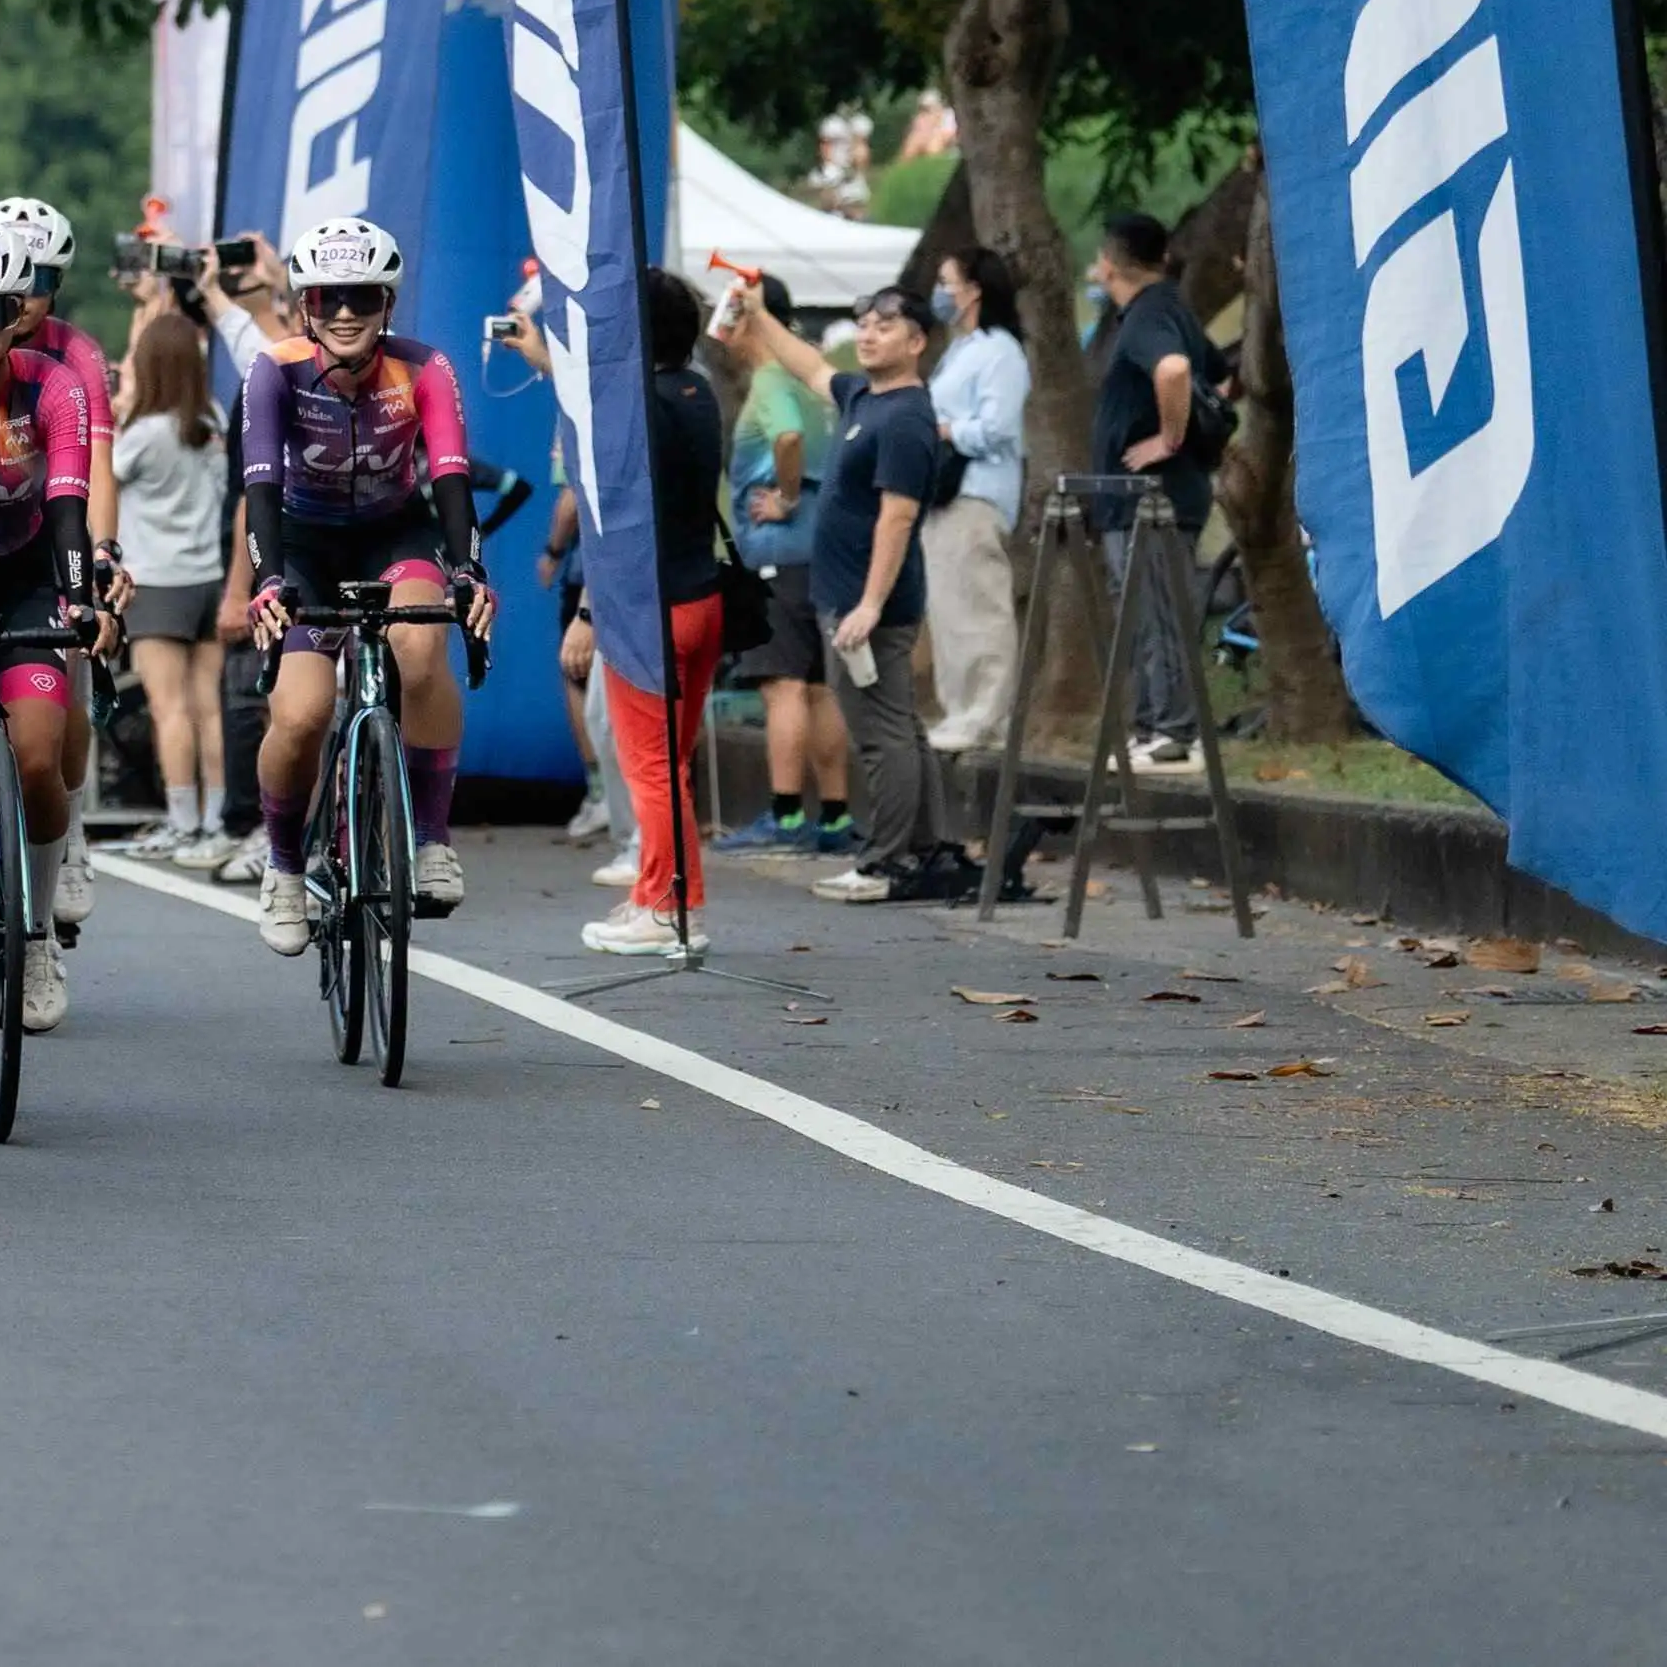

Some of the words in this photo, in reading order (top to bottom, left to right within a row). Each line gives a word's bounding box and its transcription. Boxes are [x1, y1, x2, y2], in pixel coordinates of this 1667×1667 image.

[320, 248, 366, 264] 20227
[303, 443, 405, 471] Liv
[67, 549, 83, 589] VERGE
